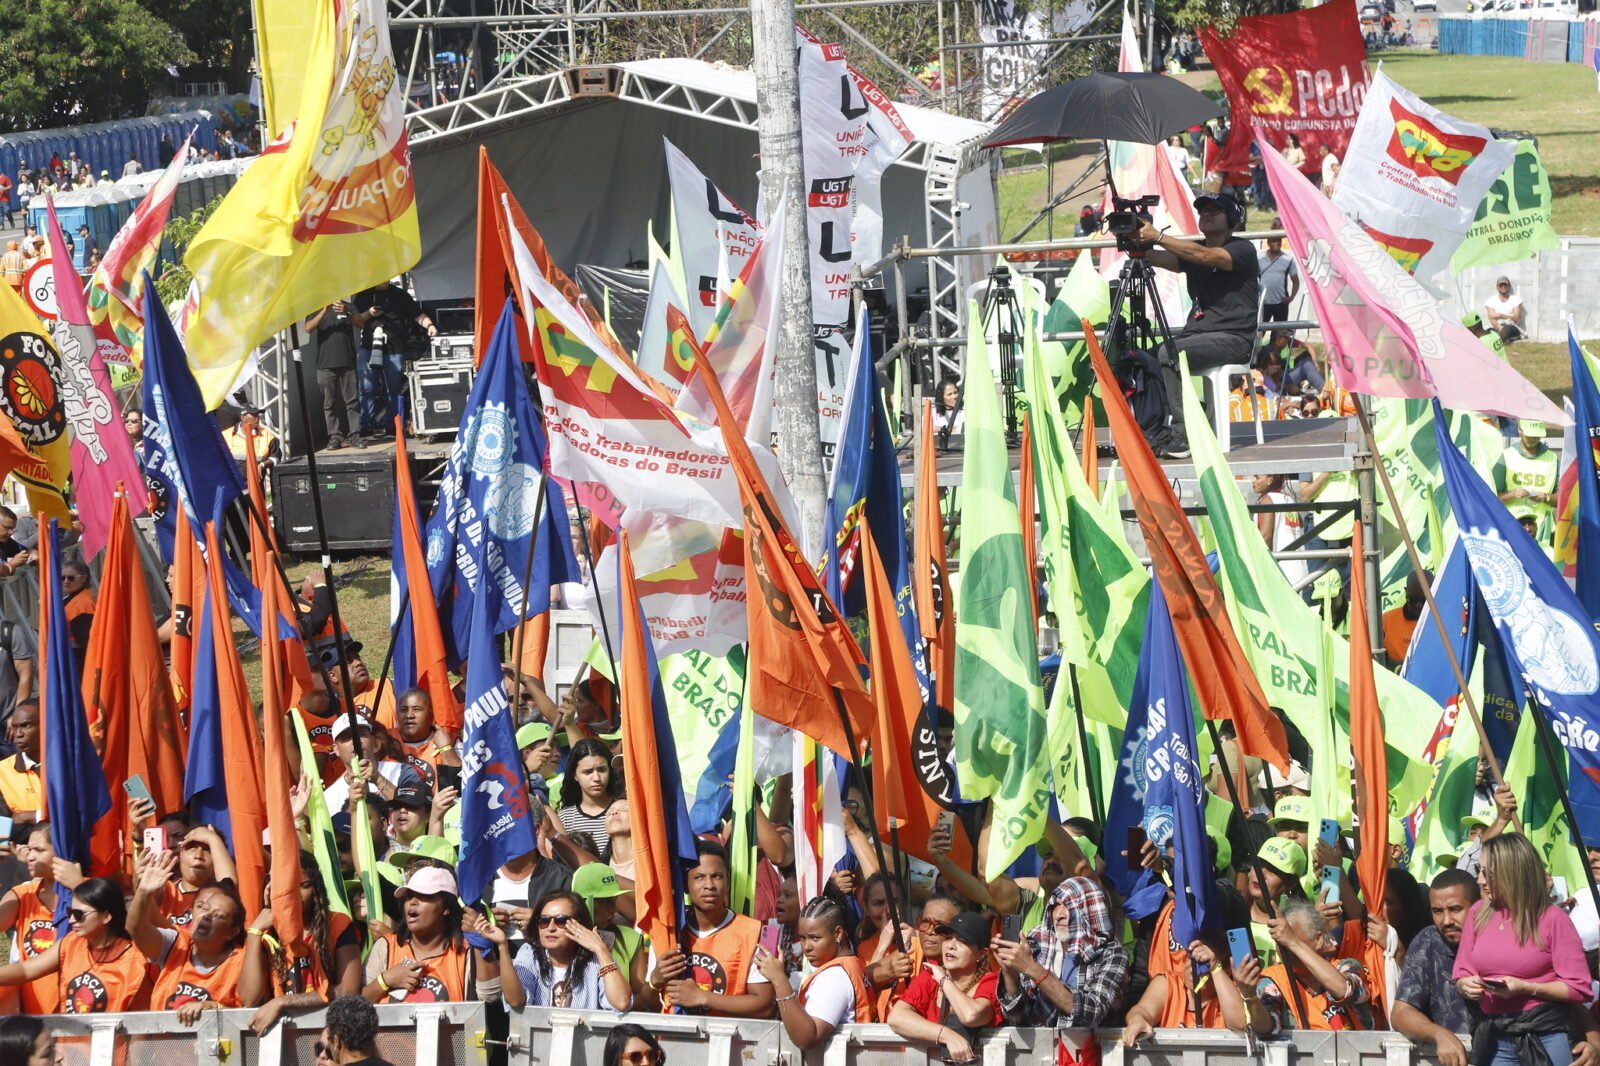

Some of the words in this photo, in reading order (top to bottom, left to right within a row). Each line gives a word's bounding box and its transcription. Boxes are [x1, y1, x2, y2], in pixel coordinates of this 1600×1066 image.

[863, 84, 888, 106] UGT
[822, 181, 847, 193] UGT
[819, 194, 843, 206] UGT
[562, 415, 589, 438] dos
[596, 433, 731, 466] Trabalhadores
[635, 458, 660, 473] do
[665, 462, 723, 481] Brasil
[1512, 472, 1546, 487] CSB
[1495, 709, 1514, 721] da
[601, 876, 615, 885] CSB
